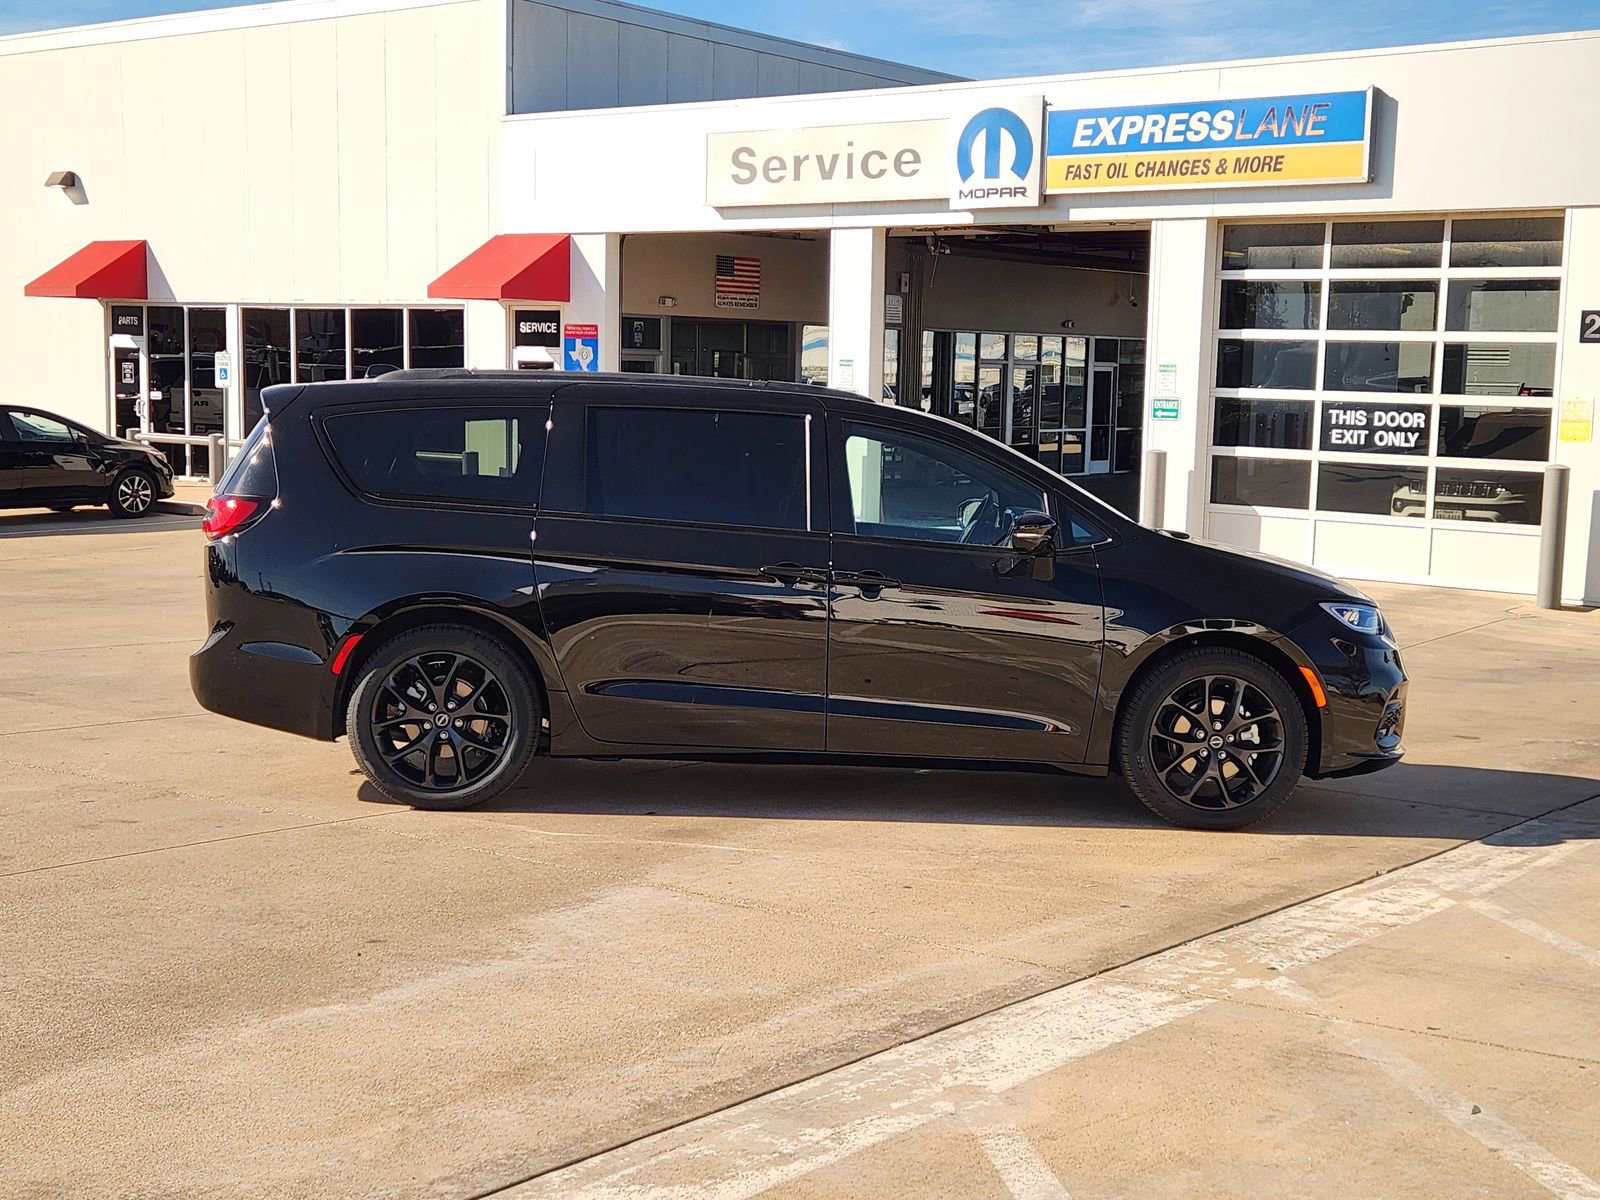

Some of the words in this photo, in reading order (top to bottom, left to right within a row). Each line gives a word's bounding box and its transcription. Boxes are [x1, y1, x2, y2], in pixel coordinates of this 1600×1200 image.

[730, 140, 922, 185] Service
[1065, 164, 1103, 181] FAST
[1106, 162, 1129, 179] OIL
[1134, 158, 1211, 178] CHANGES
[1215, 158, 1228, 175] &
[1233, 155, 1285, 174] MORE
[958, 186, 1030, 200] MOPAR
[118, 316, 139, 326] PARTS
[519, 321, 557, 334] SERVICE
[1584, 314, 1600, 339] 2
[1328, 409, 1367, 427] THIS
[1373, 411, 1426, 428] DOOR
[1330, 429, 1369, 445] EXIT
[1374, 431, 1419, 448] ONLY
